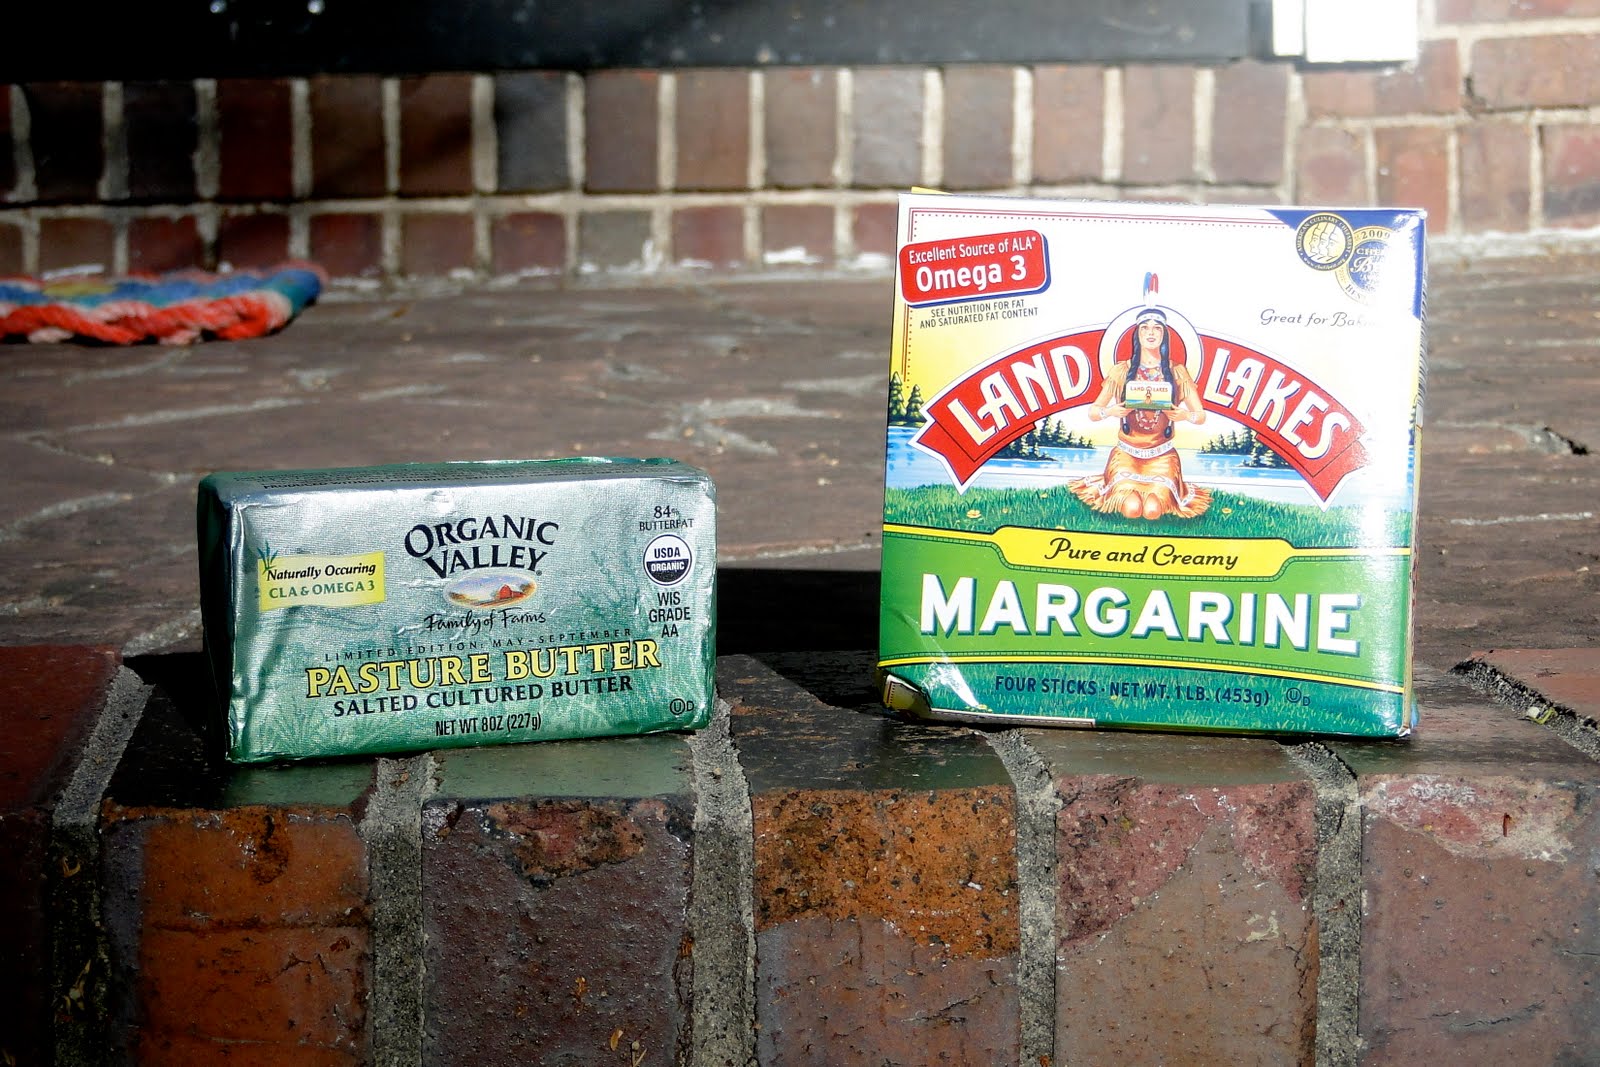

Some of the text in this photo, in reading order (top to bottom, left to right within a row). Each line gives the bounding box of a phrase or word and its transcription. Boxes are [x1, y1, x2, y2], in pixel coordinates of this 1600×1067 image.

[1361, 229, 1391, 240] 2009
[909, 245, 956, 264] Excellent
[959, 242, 995, 258] Source
[998, 239, 1009, 252] of
[916, 255, 1027, 292] Omega 3
[920, 307, 1038, 329] AND SATURATED FAT CONTENT
[930, 299, 1025, 318] SEE NUTRITION FOR FAT
[1260, 308, 1302, 326] Great
[1304, 312, 1328, 328] for
[947, 345, 1094, 446] LAND
[1202, 347, 1352, 460] LAKES
[654, 505, 679, 519] 84%
[639, 519, 695, 531] BUTTERFAT
[404, 514, 559, 558] ORGANIC
[423, 544, 548, 579] VALLEY
[654, 547, 681, 559] USDA
[1044, 537, 1239, 570] Pure and Creamy
[266, 563, 376, 581] Naturally Occuring
[650, 561, 685, 572] ORGANIC
[269, 580, 375, 599] CLA & OMEGA 3
[657, 591, 681, 606] WIS
[424, 607, 546, 636] Family of Farms
[648, 606, 691, 623] GRADE
[920, 573, 1361, 657] MARGARINE
[661, 623, 679, 638] AA
[325, 648, 395, 662] LIMITED
[305, 639, 661, 698] PASTURE BUTTER
[333, 676, 633, 717] SALTED CULTURED BUTTER
[995, 676, 1269, 707] FOUR STICKS NET WT. 1 LB. (453g)
[435, 720, 456, 736] NET
[458, 718, 478, 734] WT
[506, 712, 542, 731] (227g)
